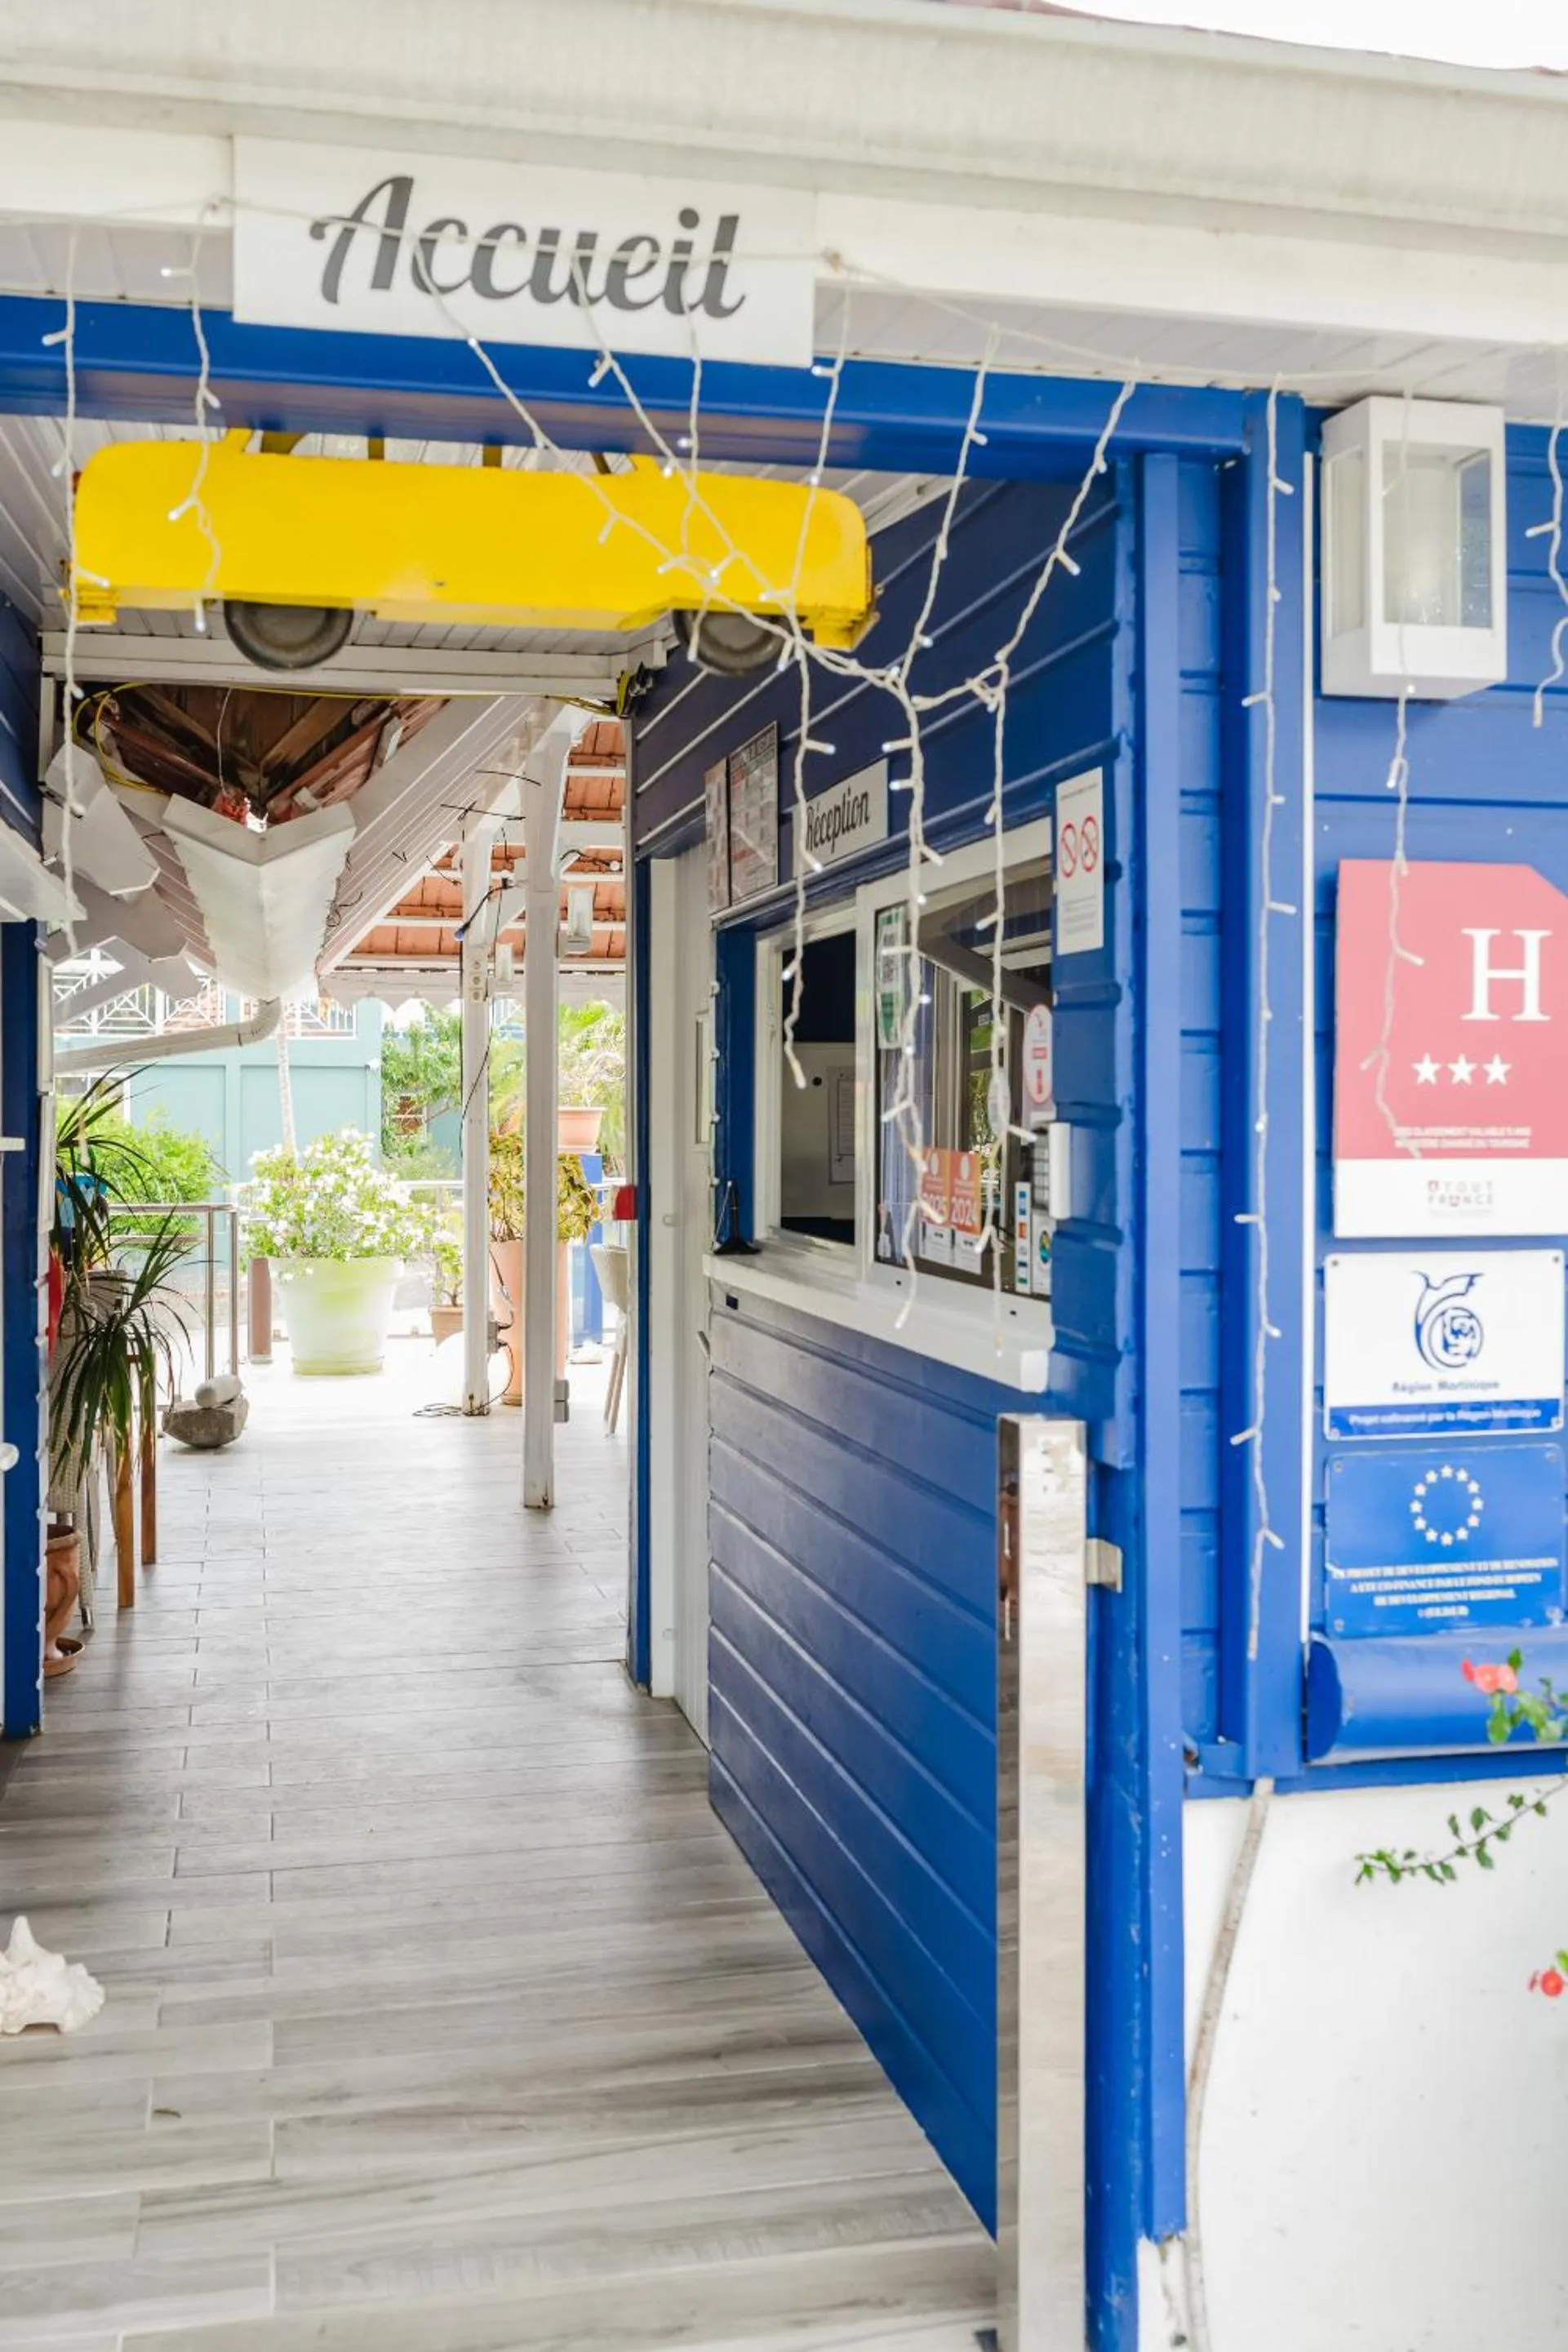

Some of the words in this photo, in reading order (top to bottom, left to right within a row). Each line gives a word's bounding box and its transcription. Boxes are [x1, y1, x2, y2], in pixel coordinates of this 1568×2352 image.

[309, 176, 746, 319] Accueil
[805, 786, 870, 855] Réception
[1460, 927, 1552, 1021] H
[1392, 1381, 1432, 1395] Région
[1437, 1379, 1500, 1393] Martinique
